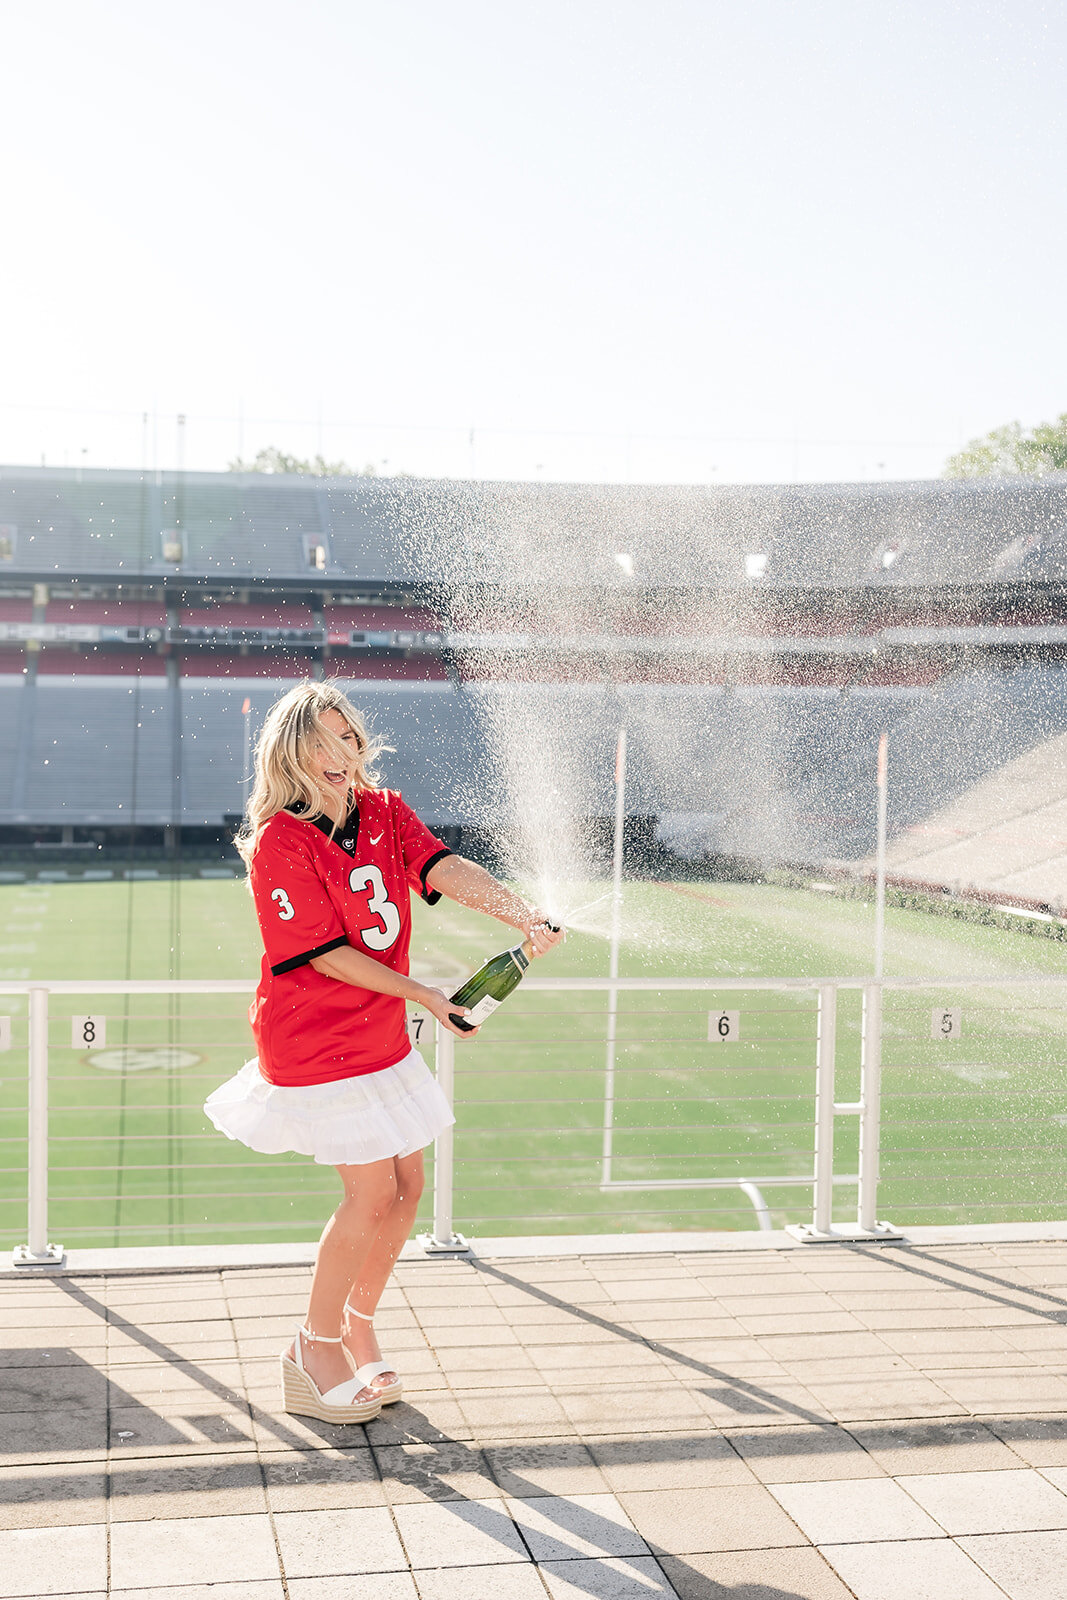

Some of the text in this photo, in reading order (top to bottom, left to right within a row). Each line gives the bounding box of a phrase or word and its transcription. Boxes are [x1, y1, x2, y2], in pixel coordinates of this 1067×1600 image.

[271, 887, 296, 921] 3
[349, 864, 401, 951] 3
[83, 1021, 96, 1042] 8
[412, 1018, 424, 1040] 7
[718, 1016, 730, 1037] 6
[940, 1013, 953, 1034] 5
